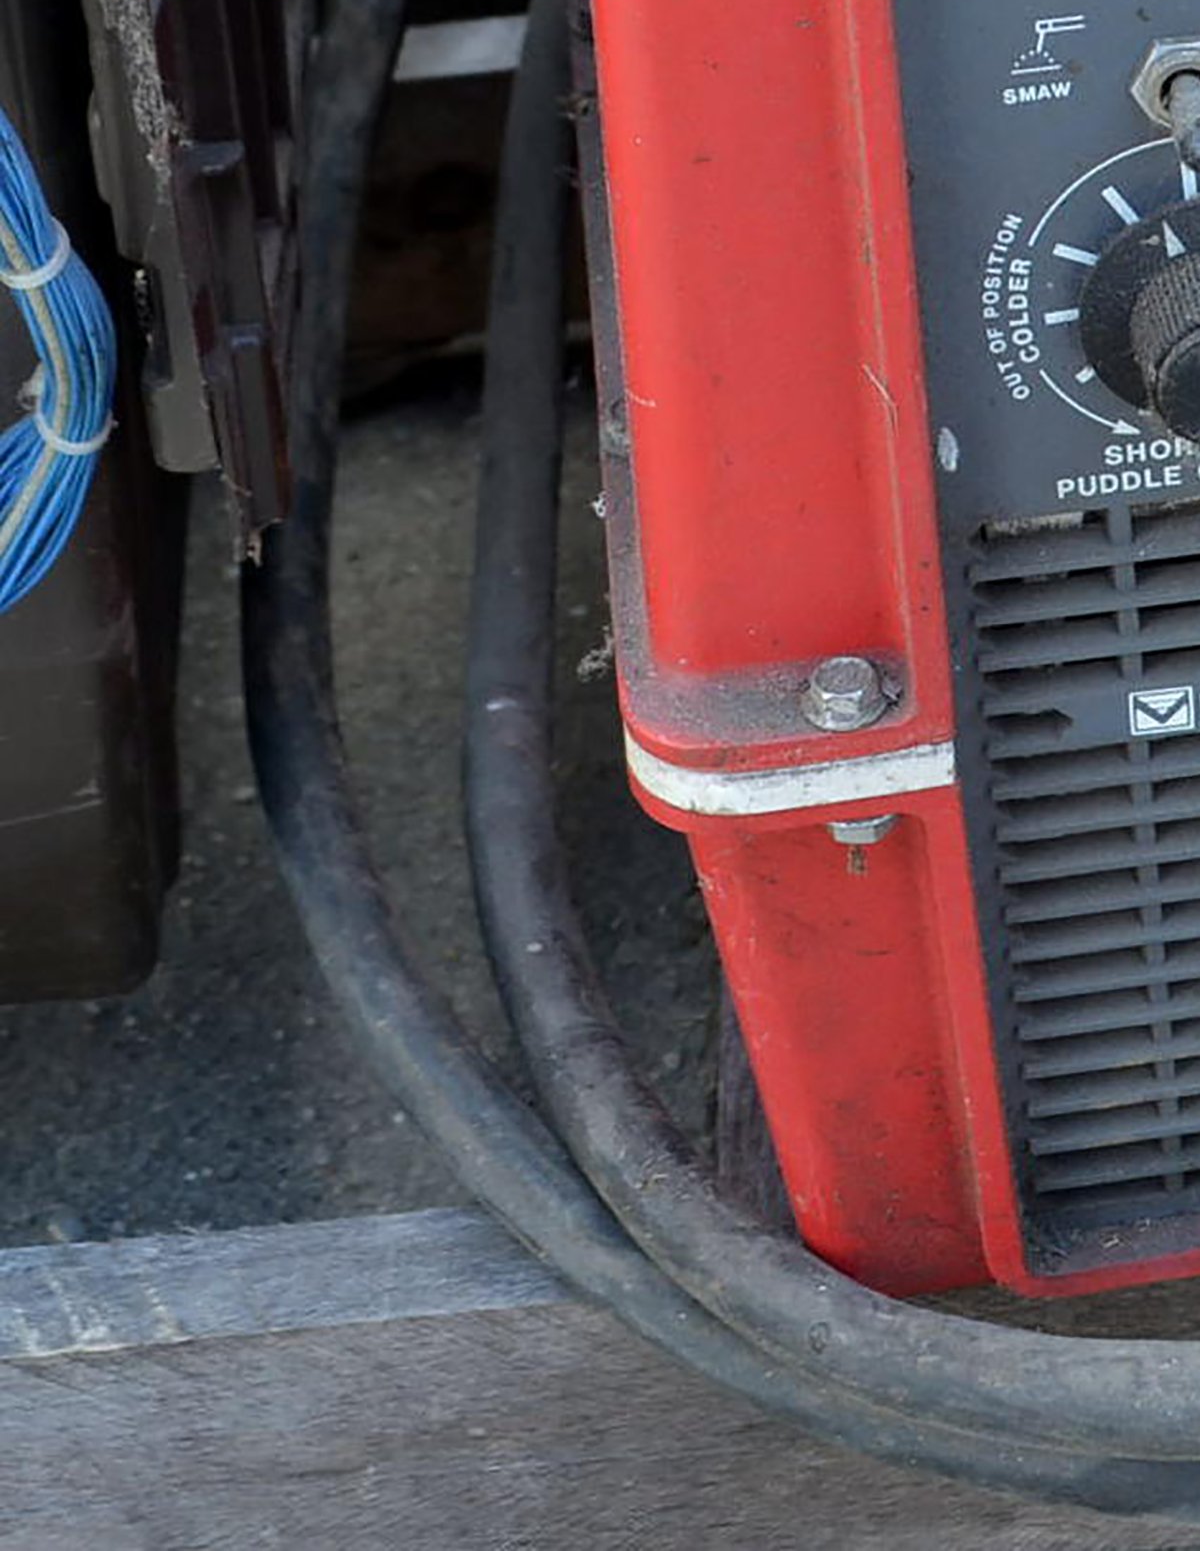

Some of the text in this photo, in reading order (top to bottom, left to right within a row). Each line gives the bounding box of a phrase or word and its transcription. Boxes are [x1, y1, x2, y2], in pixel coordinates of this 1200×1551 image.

[1002, 81, 1072, 105] SMAW
[981, 213, 1031, 400] OUT OF POSITION
[1008, 258, 1041, 363] COLDER
[1056, 464, 1183, 499] PUDDLE
